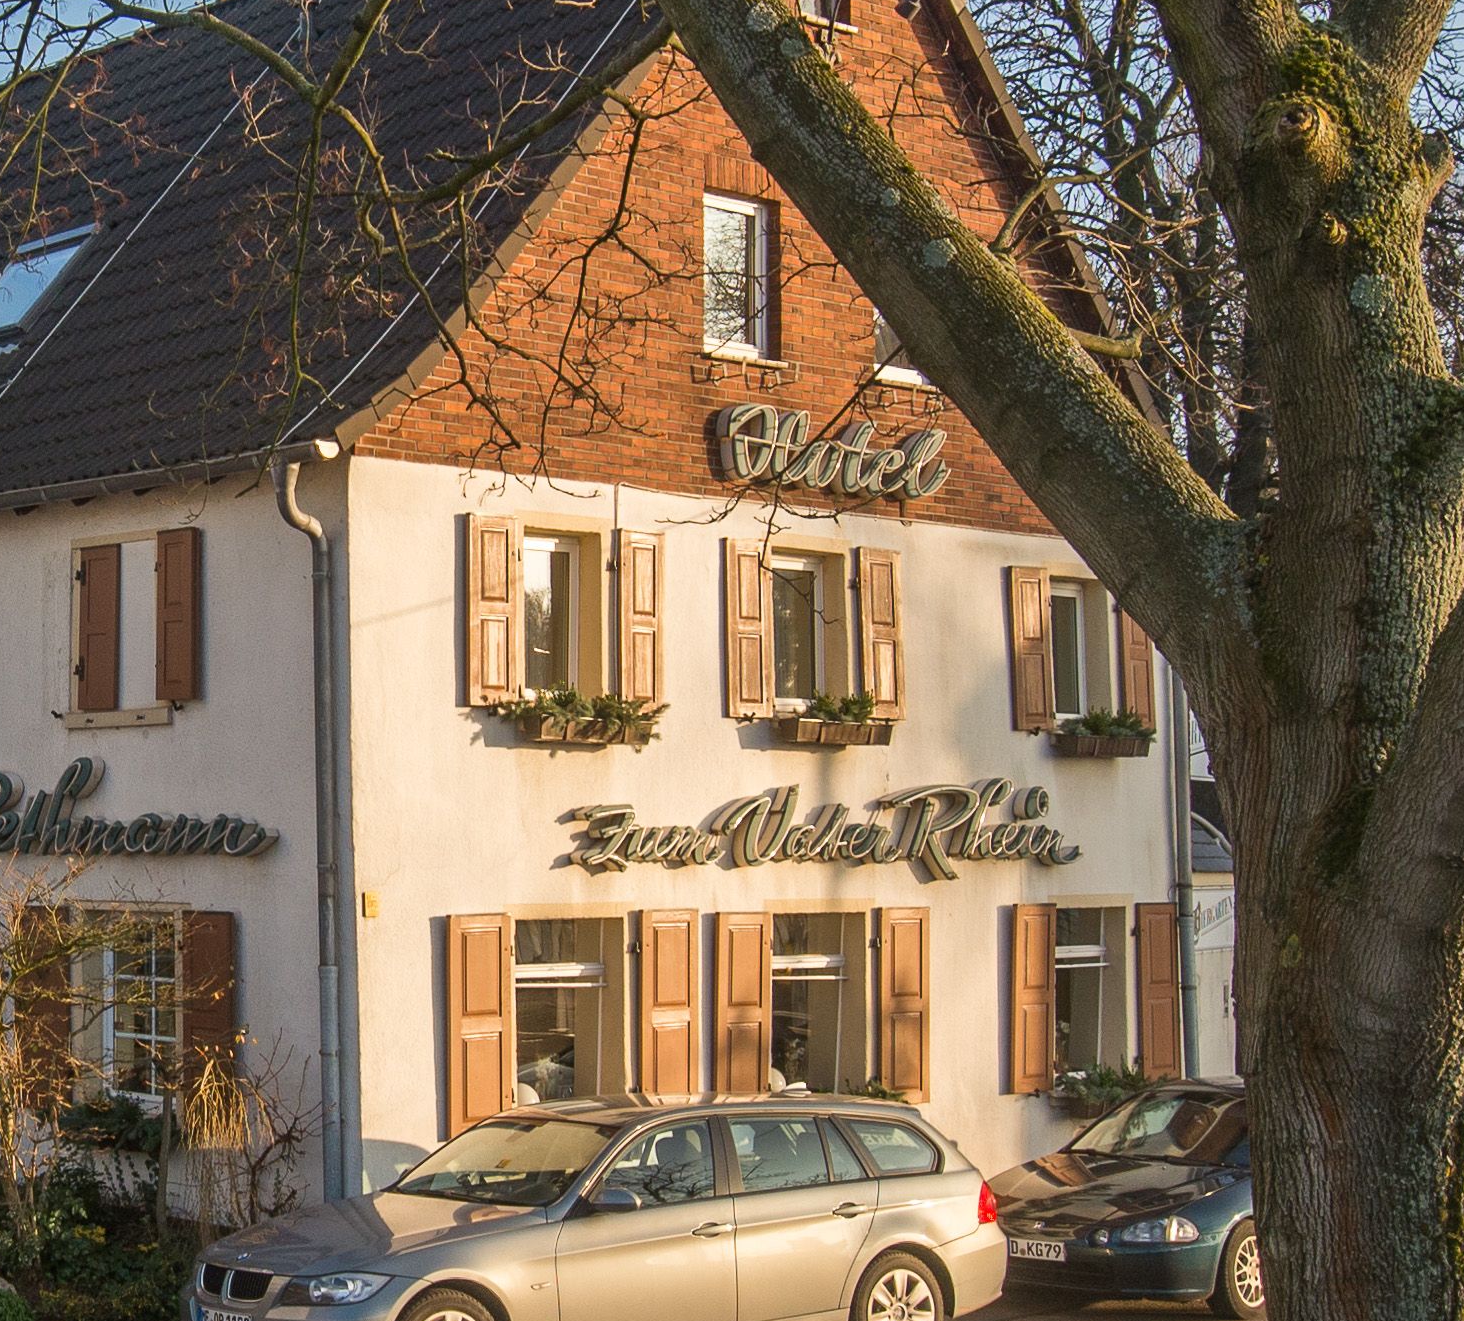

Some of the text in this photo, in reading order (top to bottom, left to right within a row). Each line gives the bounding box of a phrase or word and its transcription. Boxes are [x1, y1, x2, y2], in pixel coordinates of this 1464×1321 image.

[716, 402, 952, 500] Hotel
[712, 783, 902, 868] Vater
[874, 777, 1083, 881] Rhein
